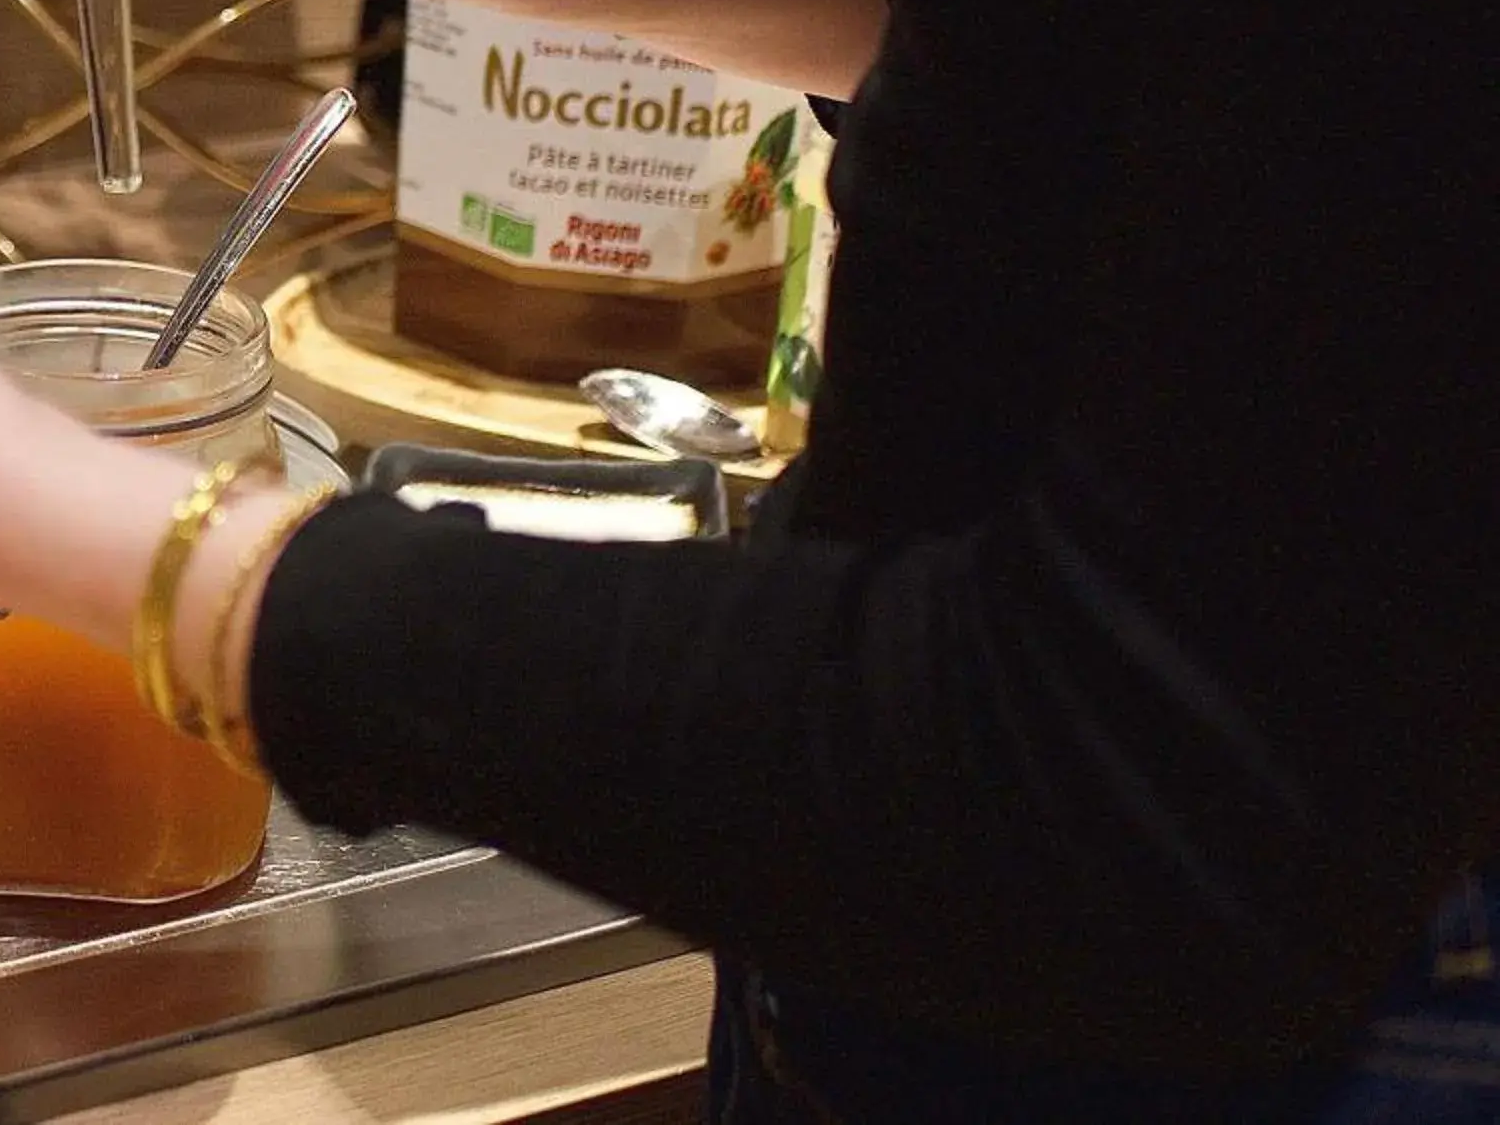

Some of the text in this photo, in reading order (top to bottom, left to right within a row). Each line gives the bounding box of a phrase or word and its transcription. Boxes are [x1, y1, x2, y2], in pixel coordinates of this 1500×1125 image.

[483, 44, 751, 138] Nocciolata
[528, 143, 697, 182] Pâte à tartiner
[575, 176, 600, 199] et
[605, 179, 710, 210] noisettes
[567, 215, 642, 246] Rigoni
